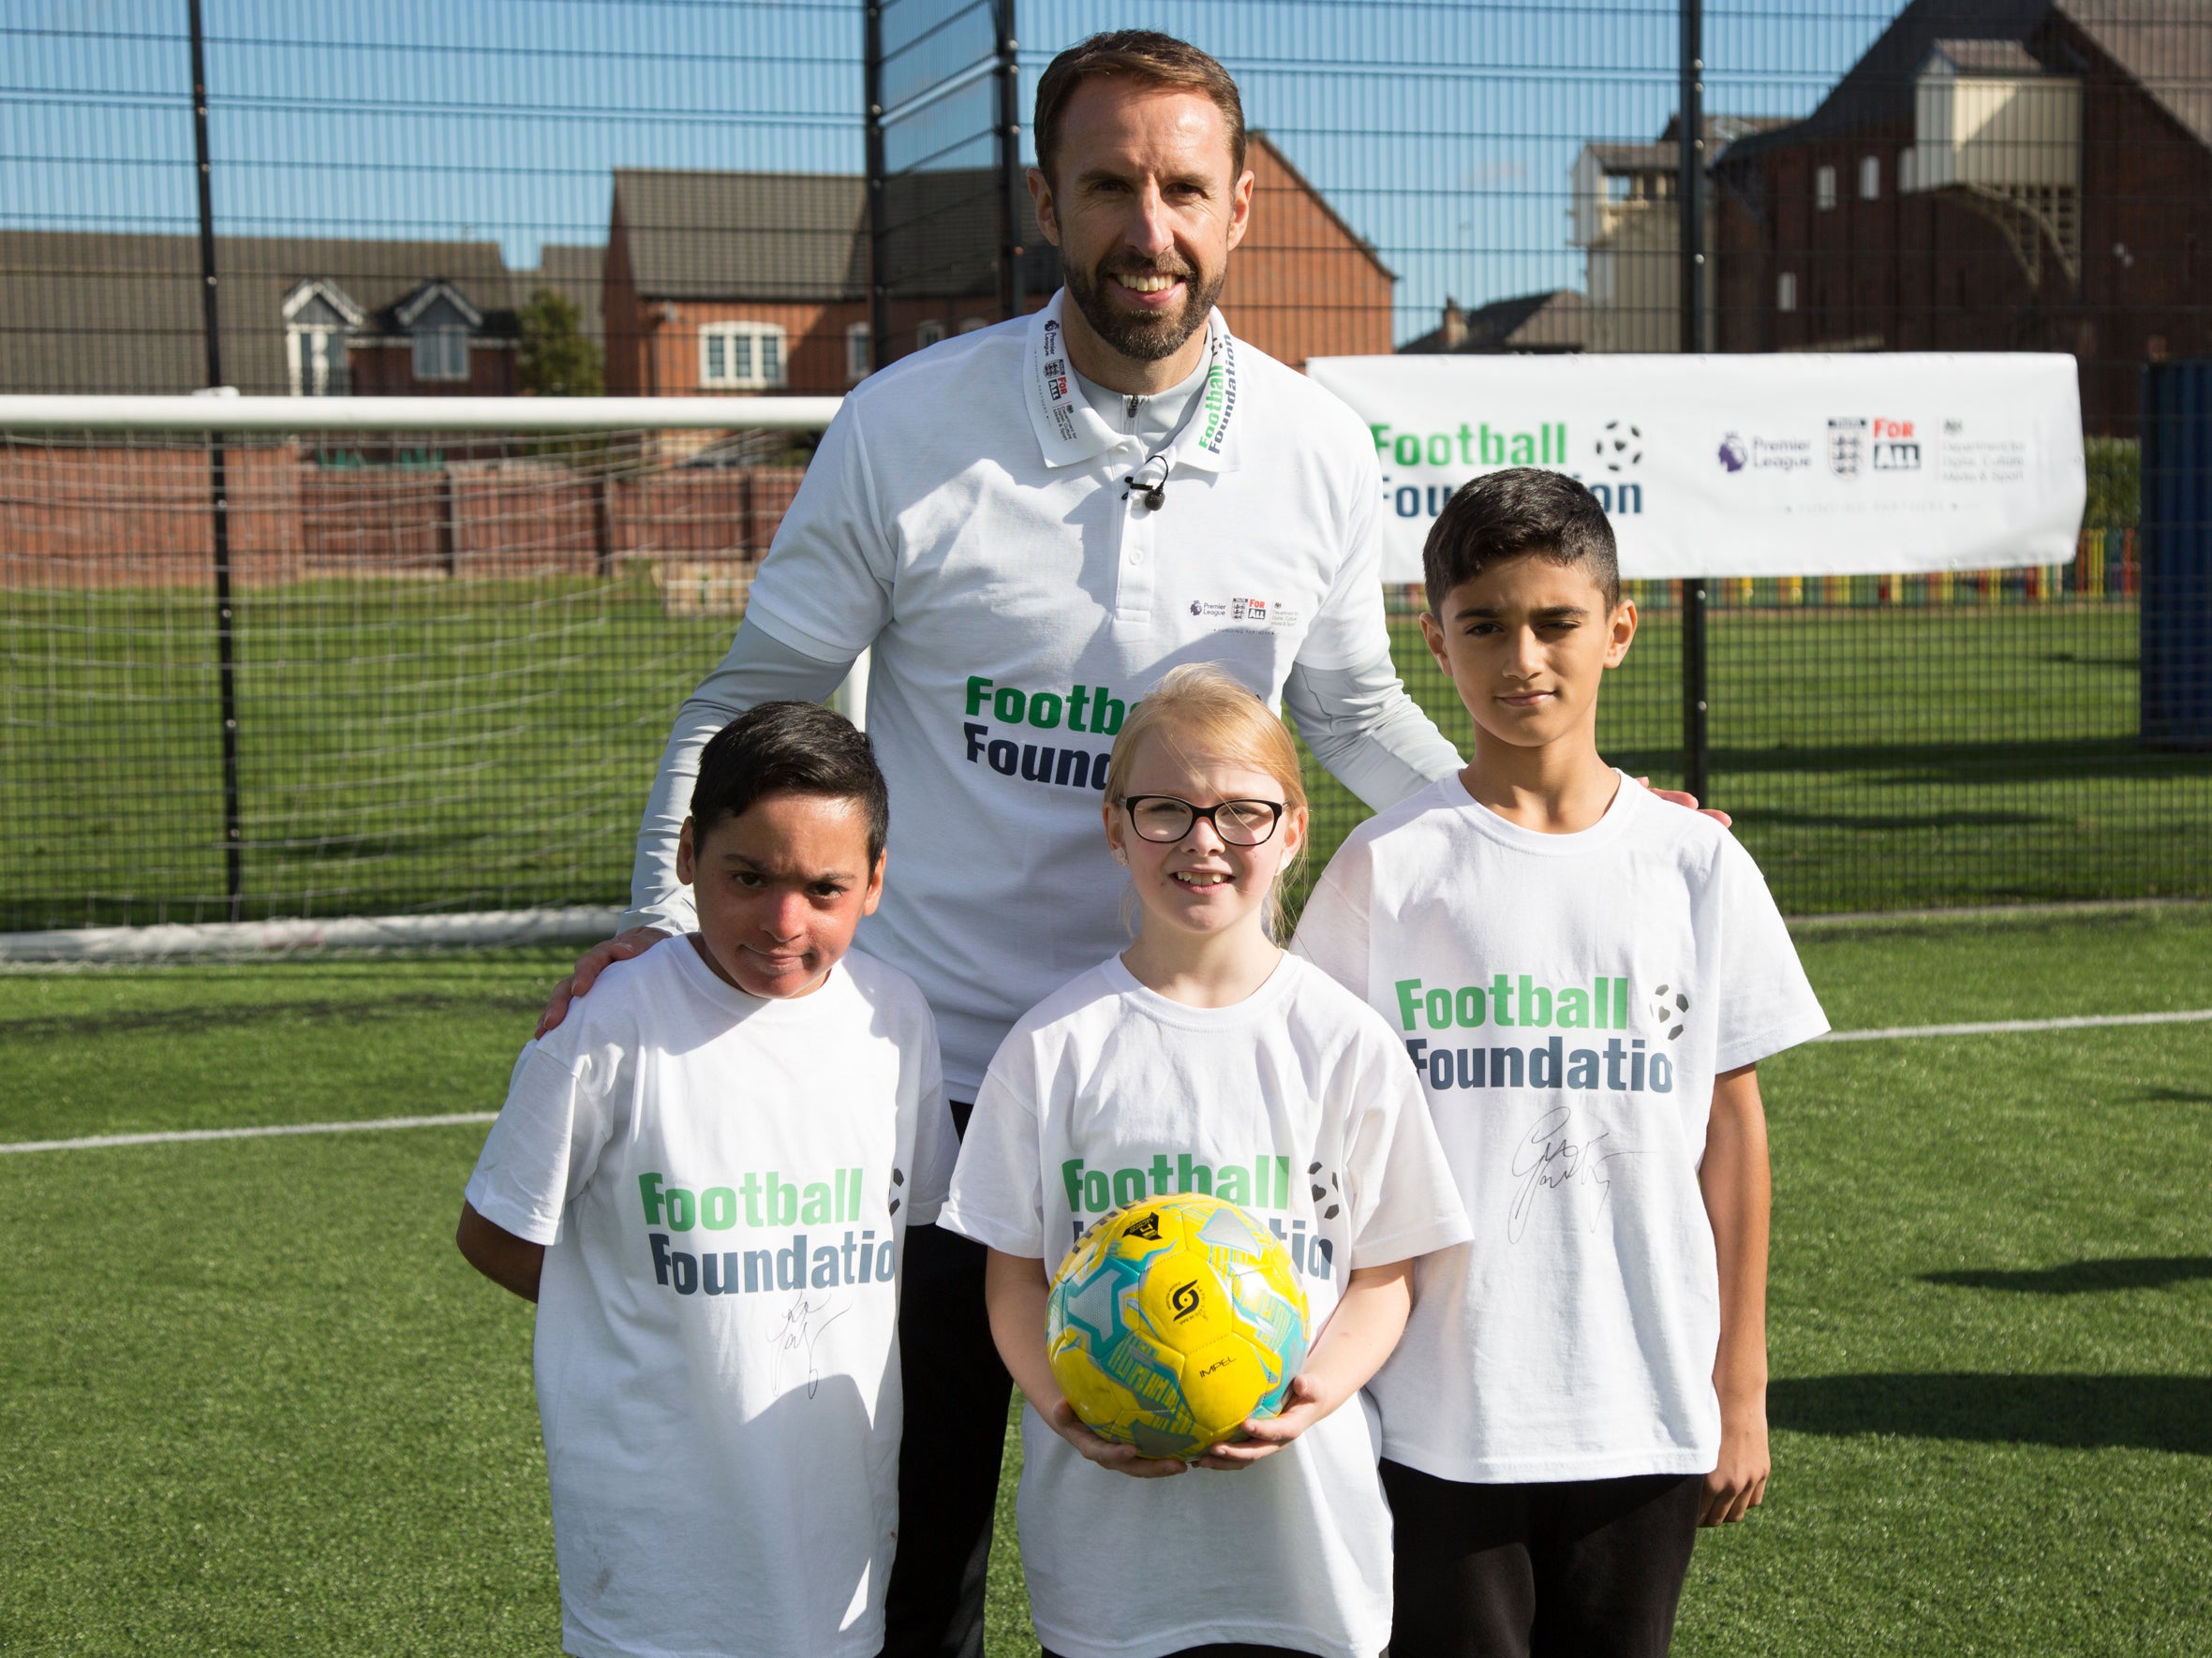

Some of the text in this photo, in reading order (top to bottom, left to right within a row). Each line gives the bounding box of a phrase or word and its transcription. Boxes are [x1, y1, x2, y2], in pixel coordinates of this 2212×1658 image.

[1058, 377, 1067, 394] FOR
[1198, 365, 1224, 449] Football
[1208, 334, 1237, 454] Foundation
[1370, 423, 1566, 466] Football
[1753, 438, 1811, 452] Premier
[1874, 420, 1913, 438] FOR
[1753, 454, 1812, 470] League
[1876, 445, 1917, 468] ALL
[1249, 599, 1266, 609] FOR
[1249, 609, 1265, 619] ALL
[965, 675, 1143, 735] Footb
[1395, 974, 1628, 1030] Football
[1405, 1036, 1673, 1093] Foundatio
[638, 1168, 863, 1233] Football
[1061, 1153, 1290, 1213] Football
[648, 1230, 895, 1296] Foundatio
[1199, 1356, 1237, 1378] IMPEL
